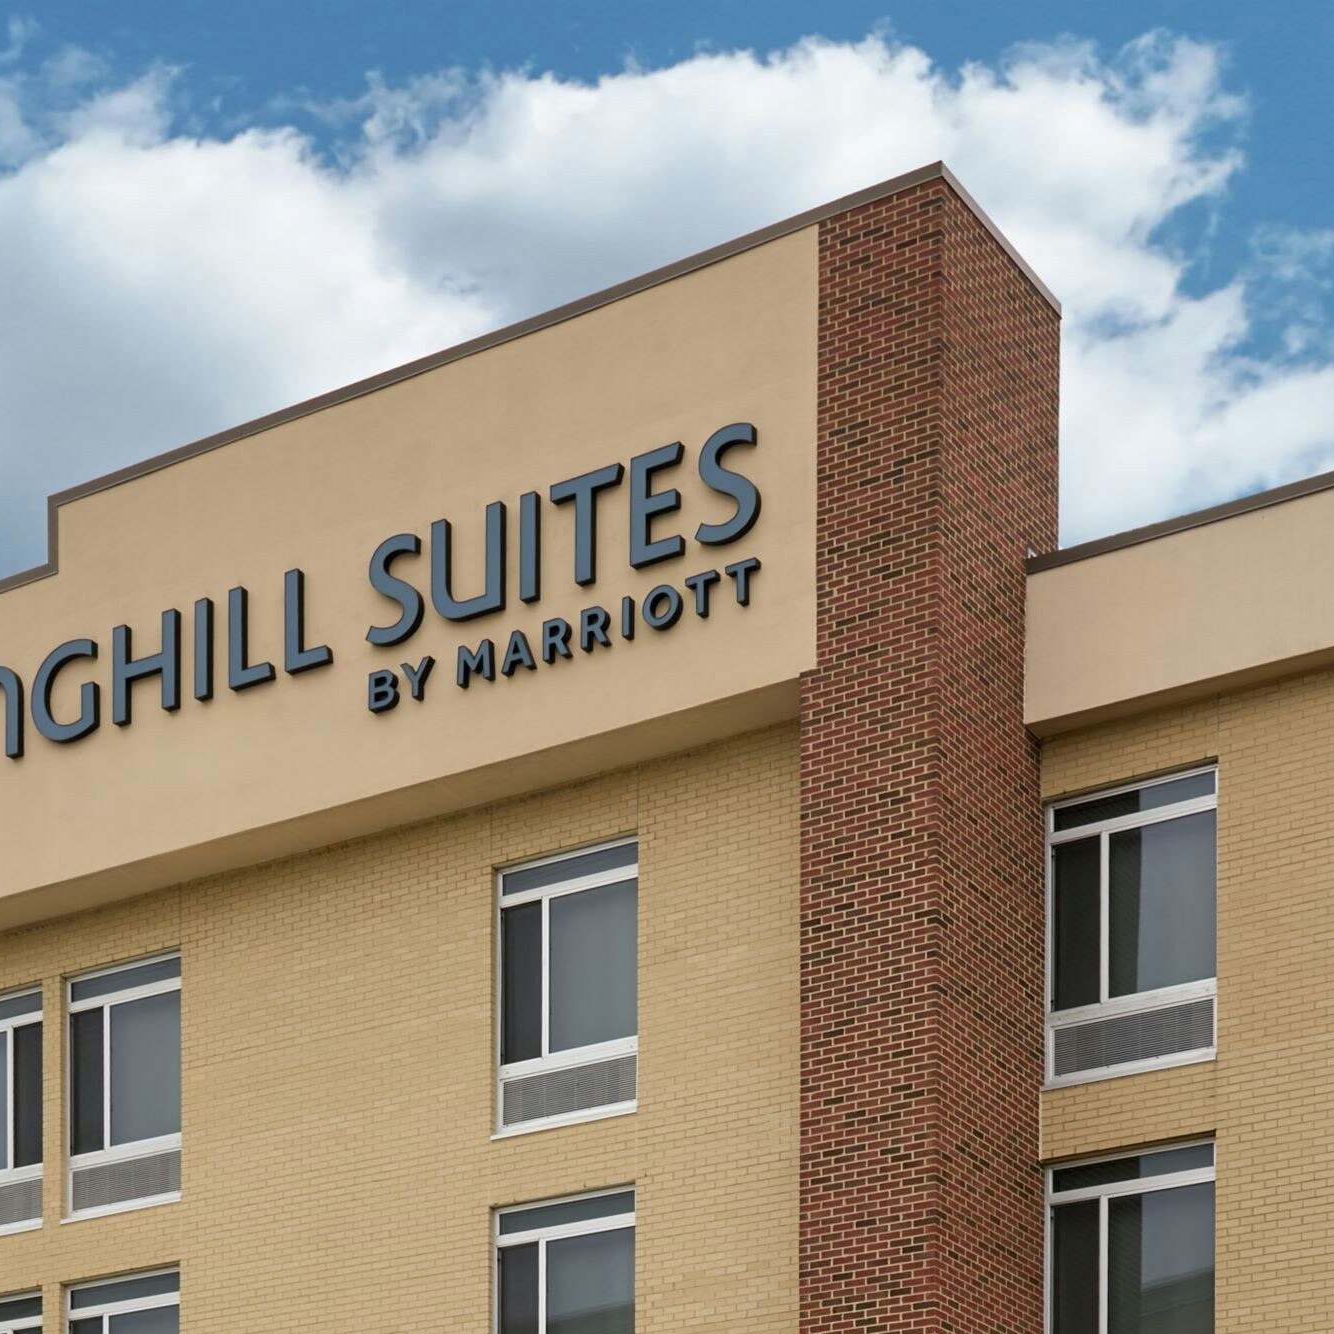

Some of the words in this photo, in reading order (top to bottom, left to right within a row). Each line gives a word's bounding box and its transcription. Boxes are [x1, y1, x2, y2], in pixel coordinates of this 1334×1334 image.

[364, 422, 763, 654] SUITES
[367, 655, 437, 716] BY
[456, 556, 763, 692] MARRIOTT
